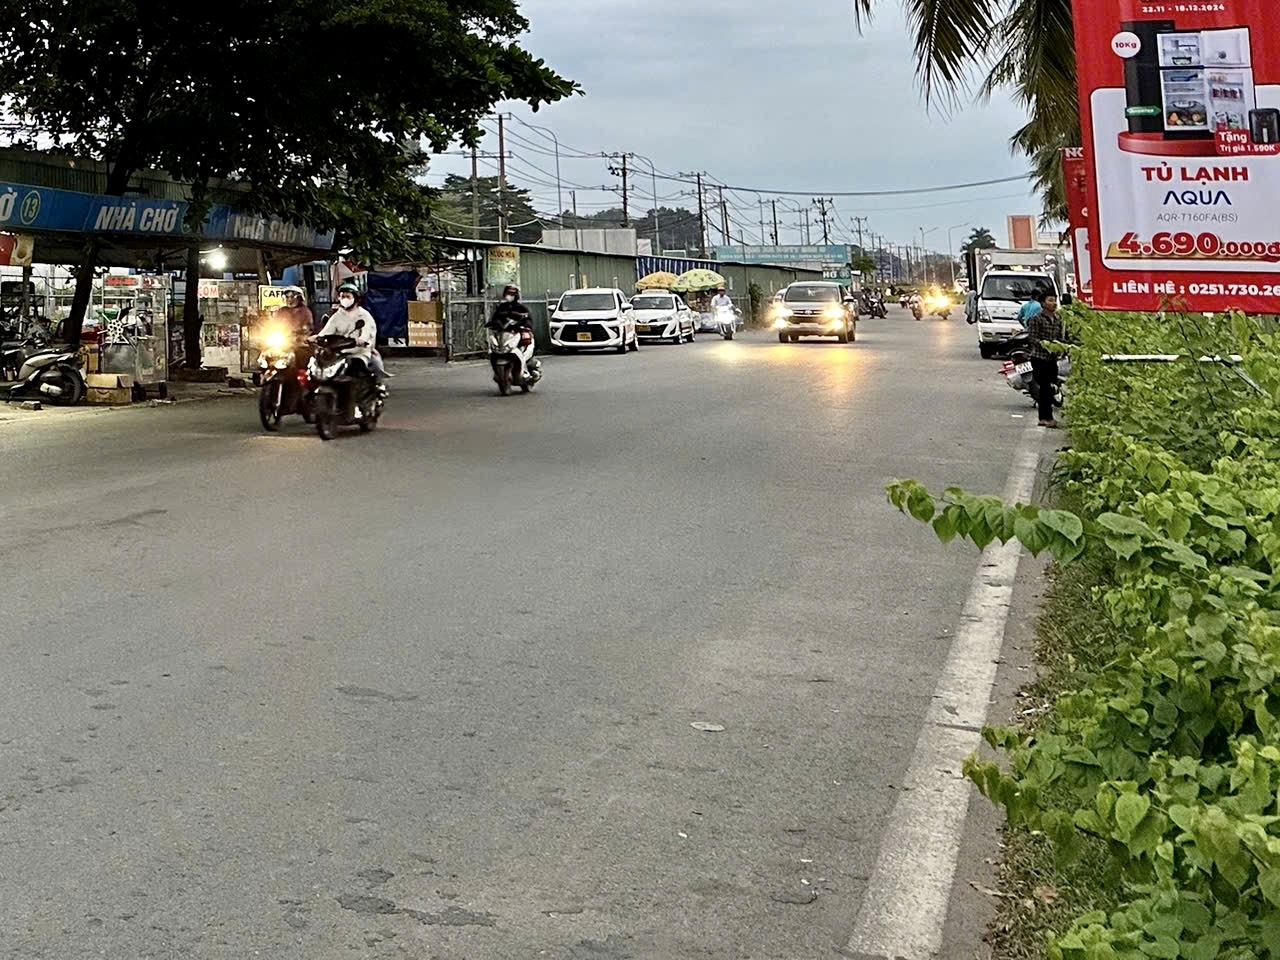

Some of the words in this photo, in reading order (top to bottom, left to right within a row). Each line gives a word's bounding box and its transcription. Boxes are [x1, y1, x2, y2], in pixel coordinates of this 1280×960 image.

[1219, 131, 1247, 144] Tặng
[1141, 161, 1173, 181] TỦ
[1180, 167, 1249, 186] LẠNH
[23, 196, 40, 218] 13
[1163, 190, 1232, 205] AQUA
[94, 201, 137, 231] NHÀ
[139, 203, 180, 233] CHỜ
[1113, 279, 1148, 293] LIÊN
[1188, 283, 1280, 296] 0251.730.26
